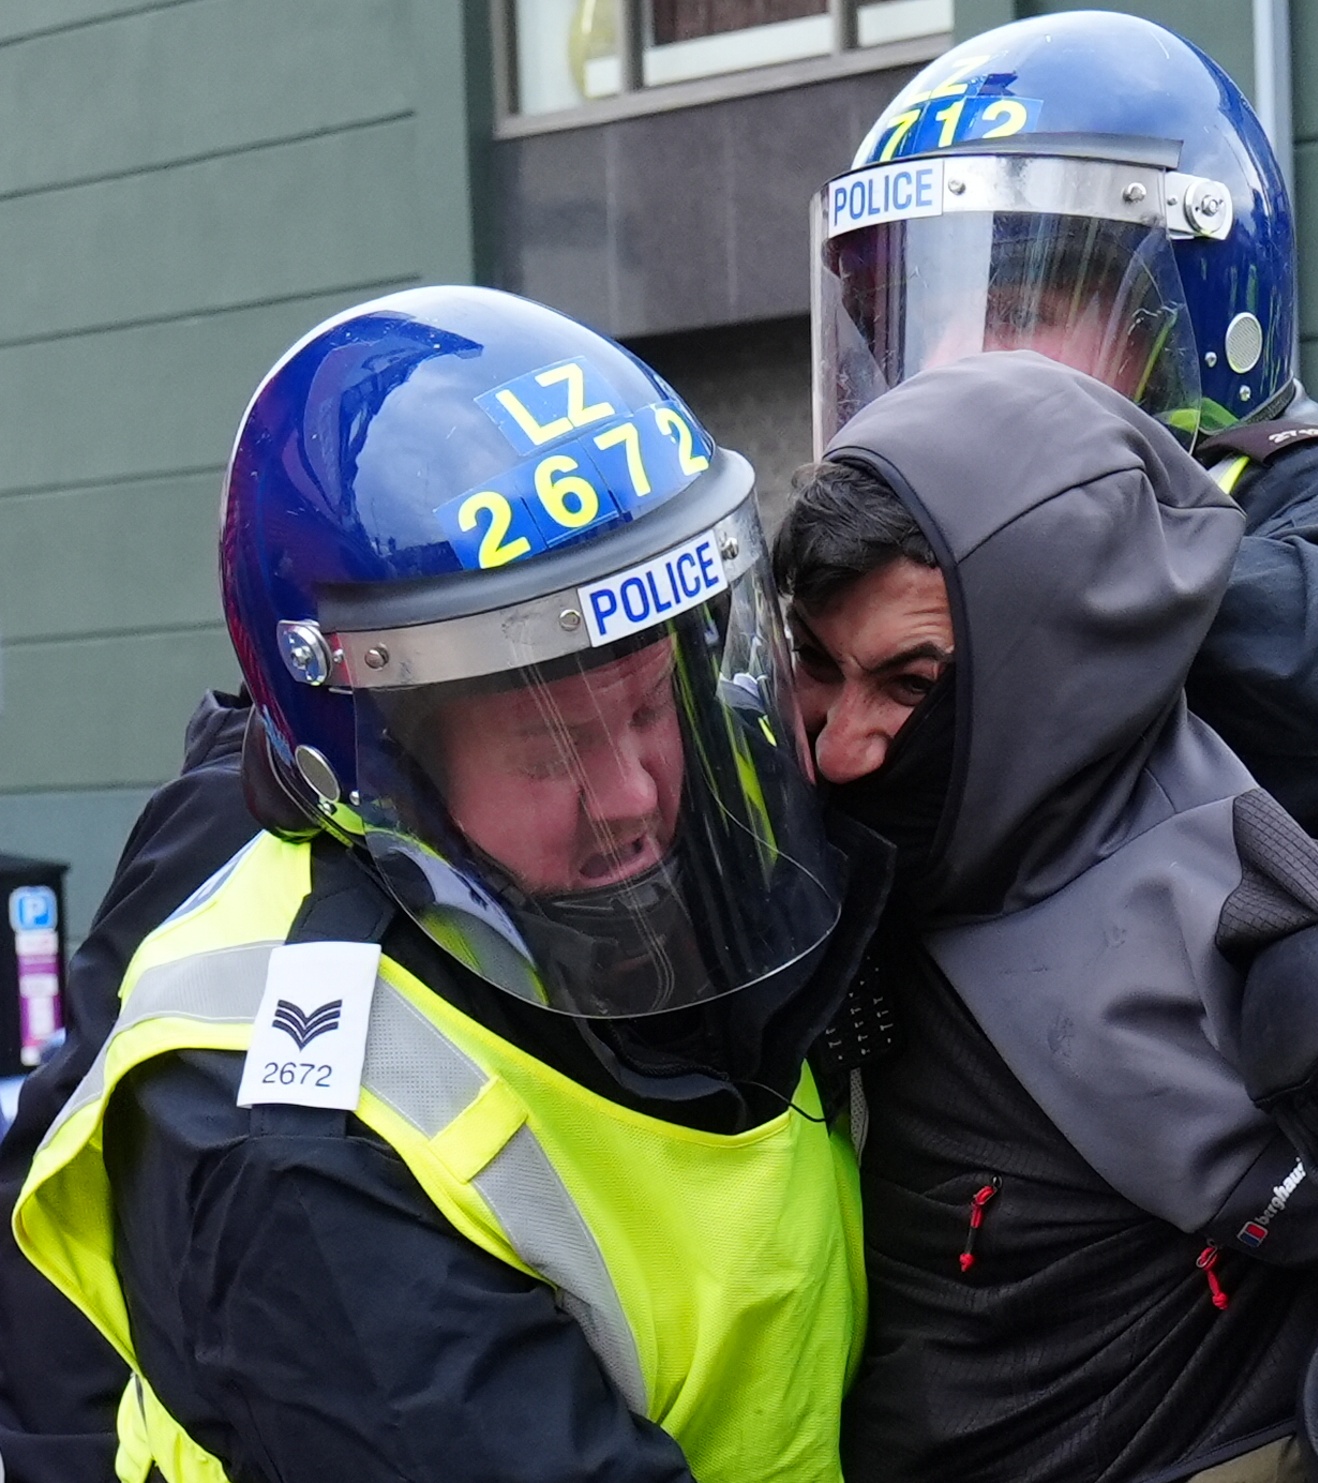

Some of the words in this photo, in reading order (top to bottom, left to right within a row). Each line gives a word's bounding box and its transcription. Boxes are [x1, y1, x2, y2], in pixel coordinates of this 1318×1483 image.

[833, 168, 934, 227] POLICE
[495, 362, 616, 446] LZ
[458, 406, 710, 569] 2672
[588, 541, 720, 636] POLICE
[262, 1061, 333, 1088] 2672
